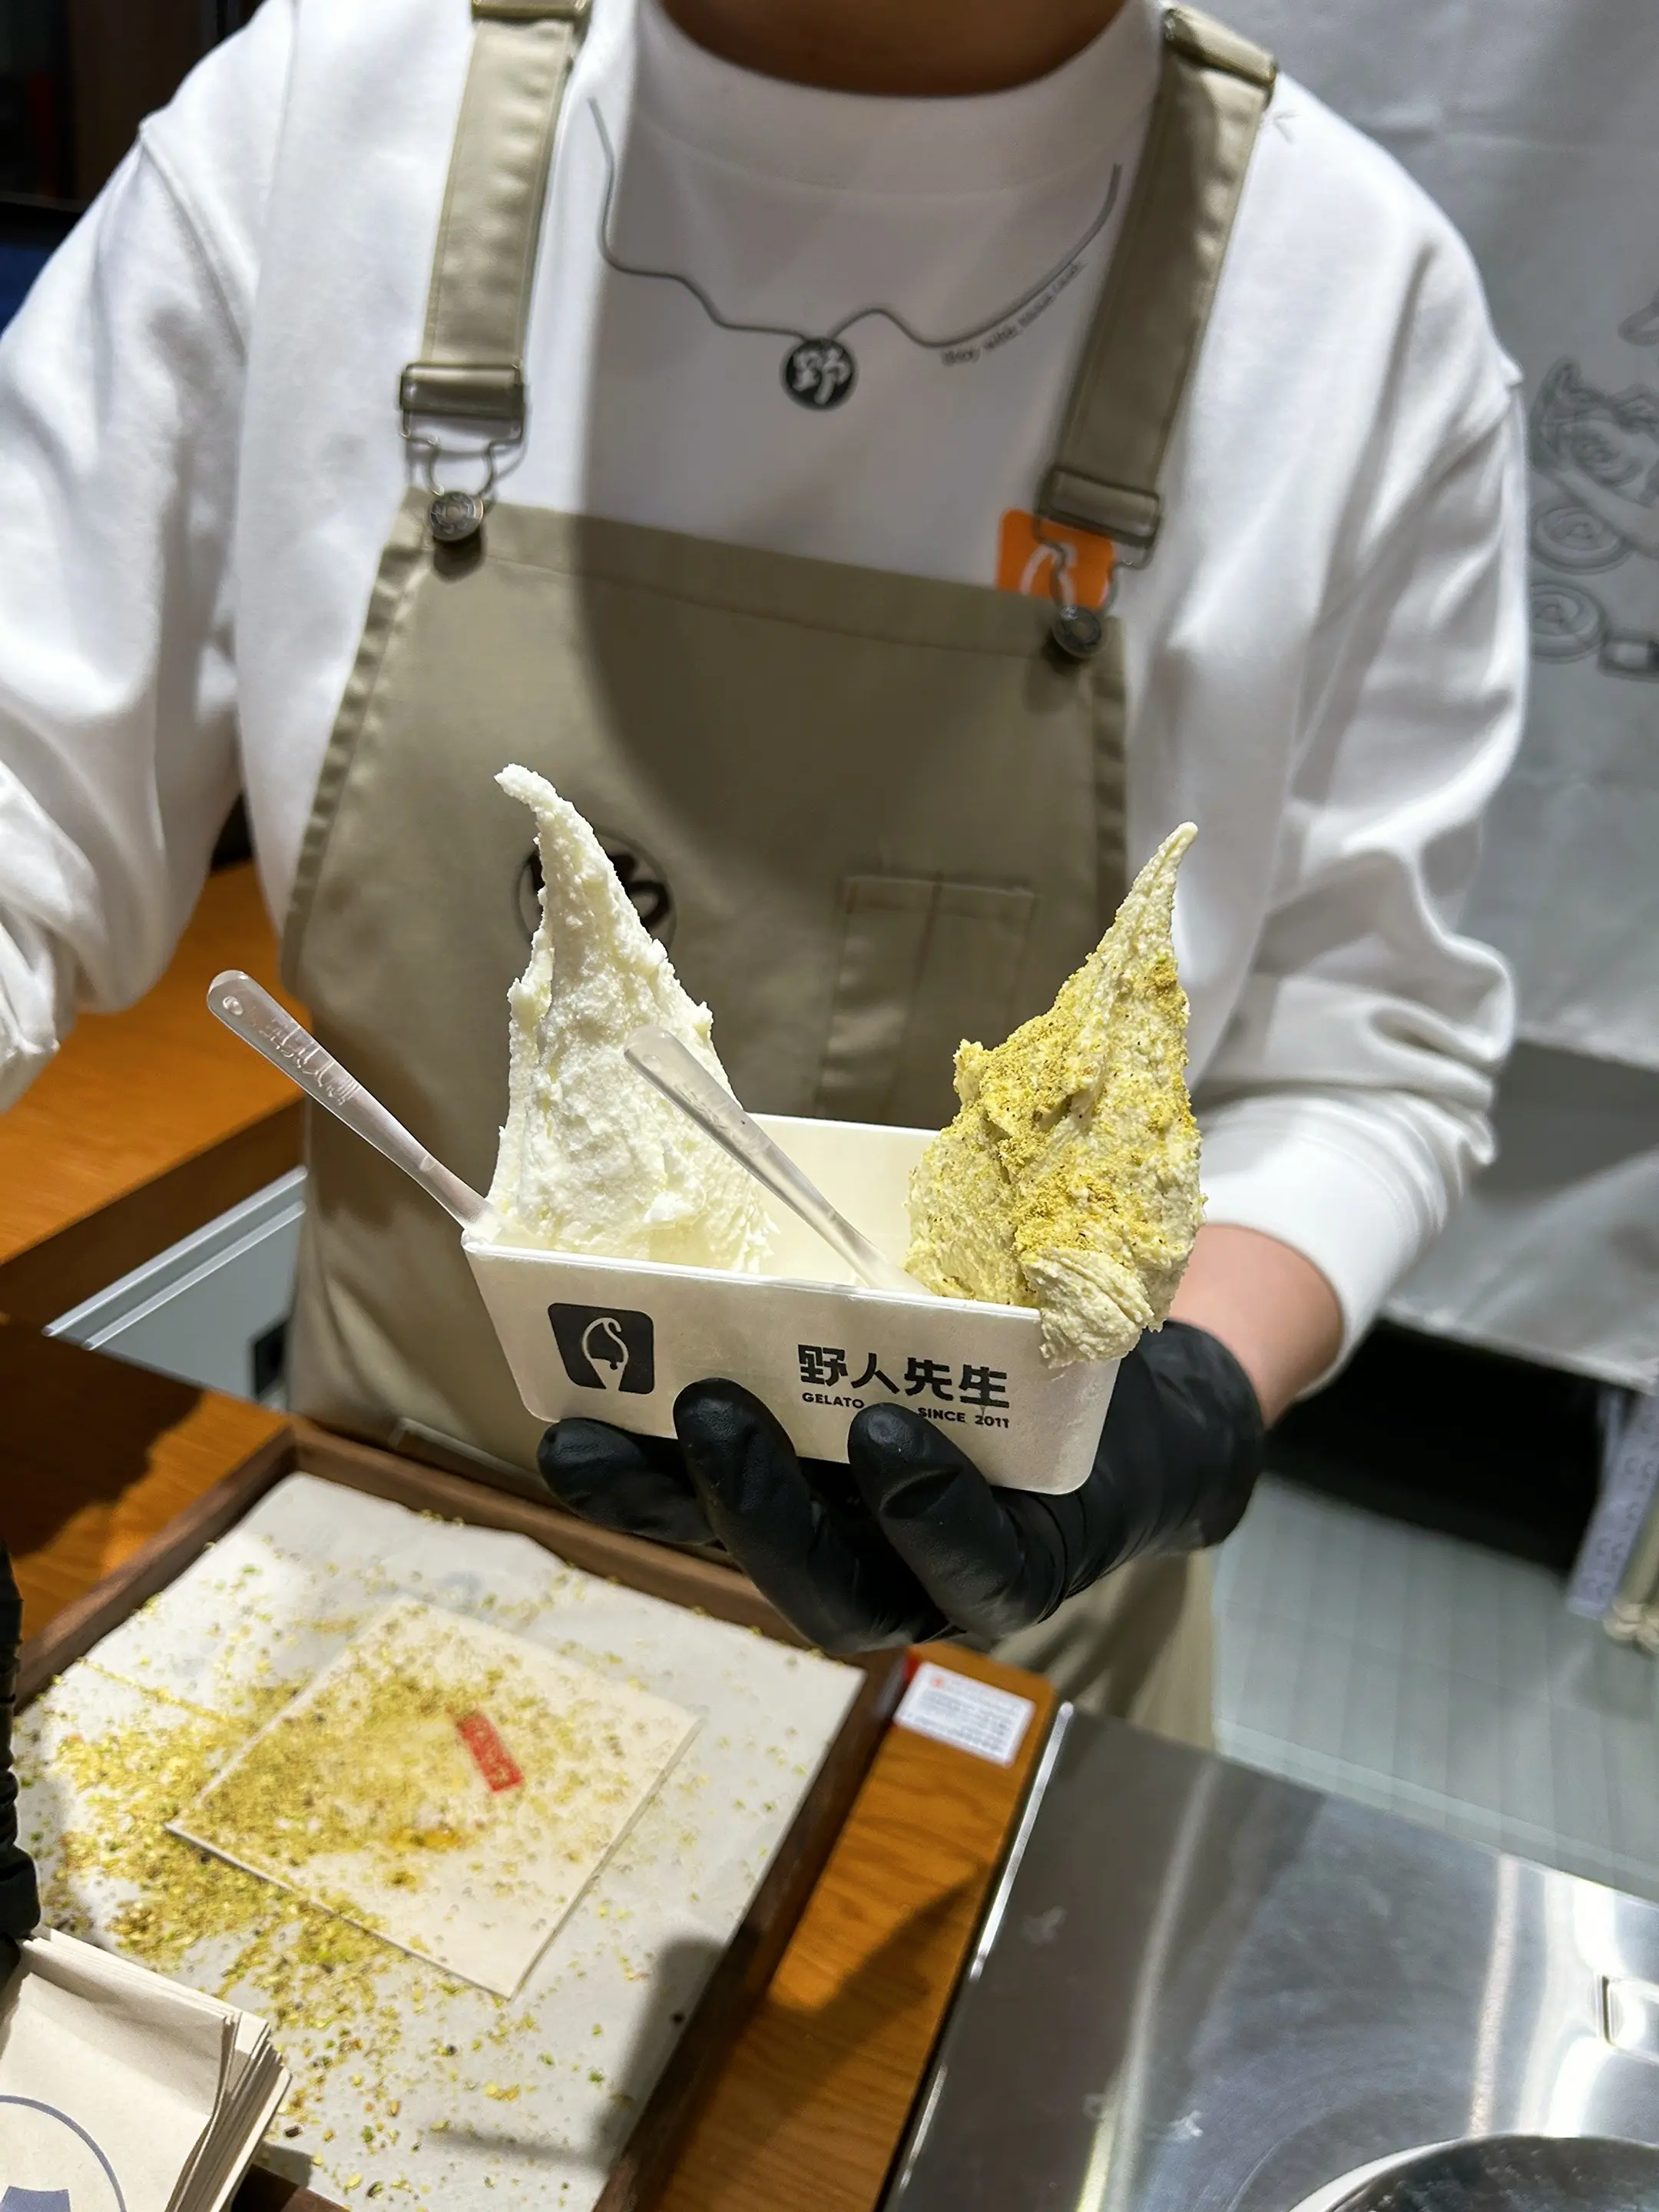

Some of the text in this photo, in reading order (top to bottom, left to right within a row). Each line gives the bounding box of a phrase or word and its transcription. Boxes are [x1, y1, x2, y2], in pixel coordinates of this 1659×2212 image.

[797, 1344, 1009, 1409] 野人先生
[802, 1392, 1010, 1429] GELATO SINCE 2011
